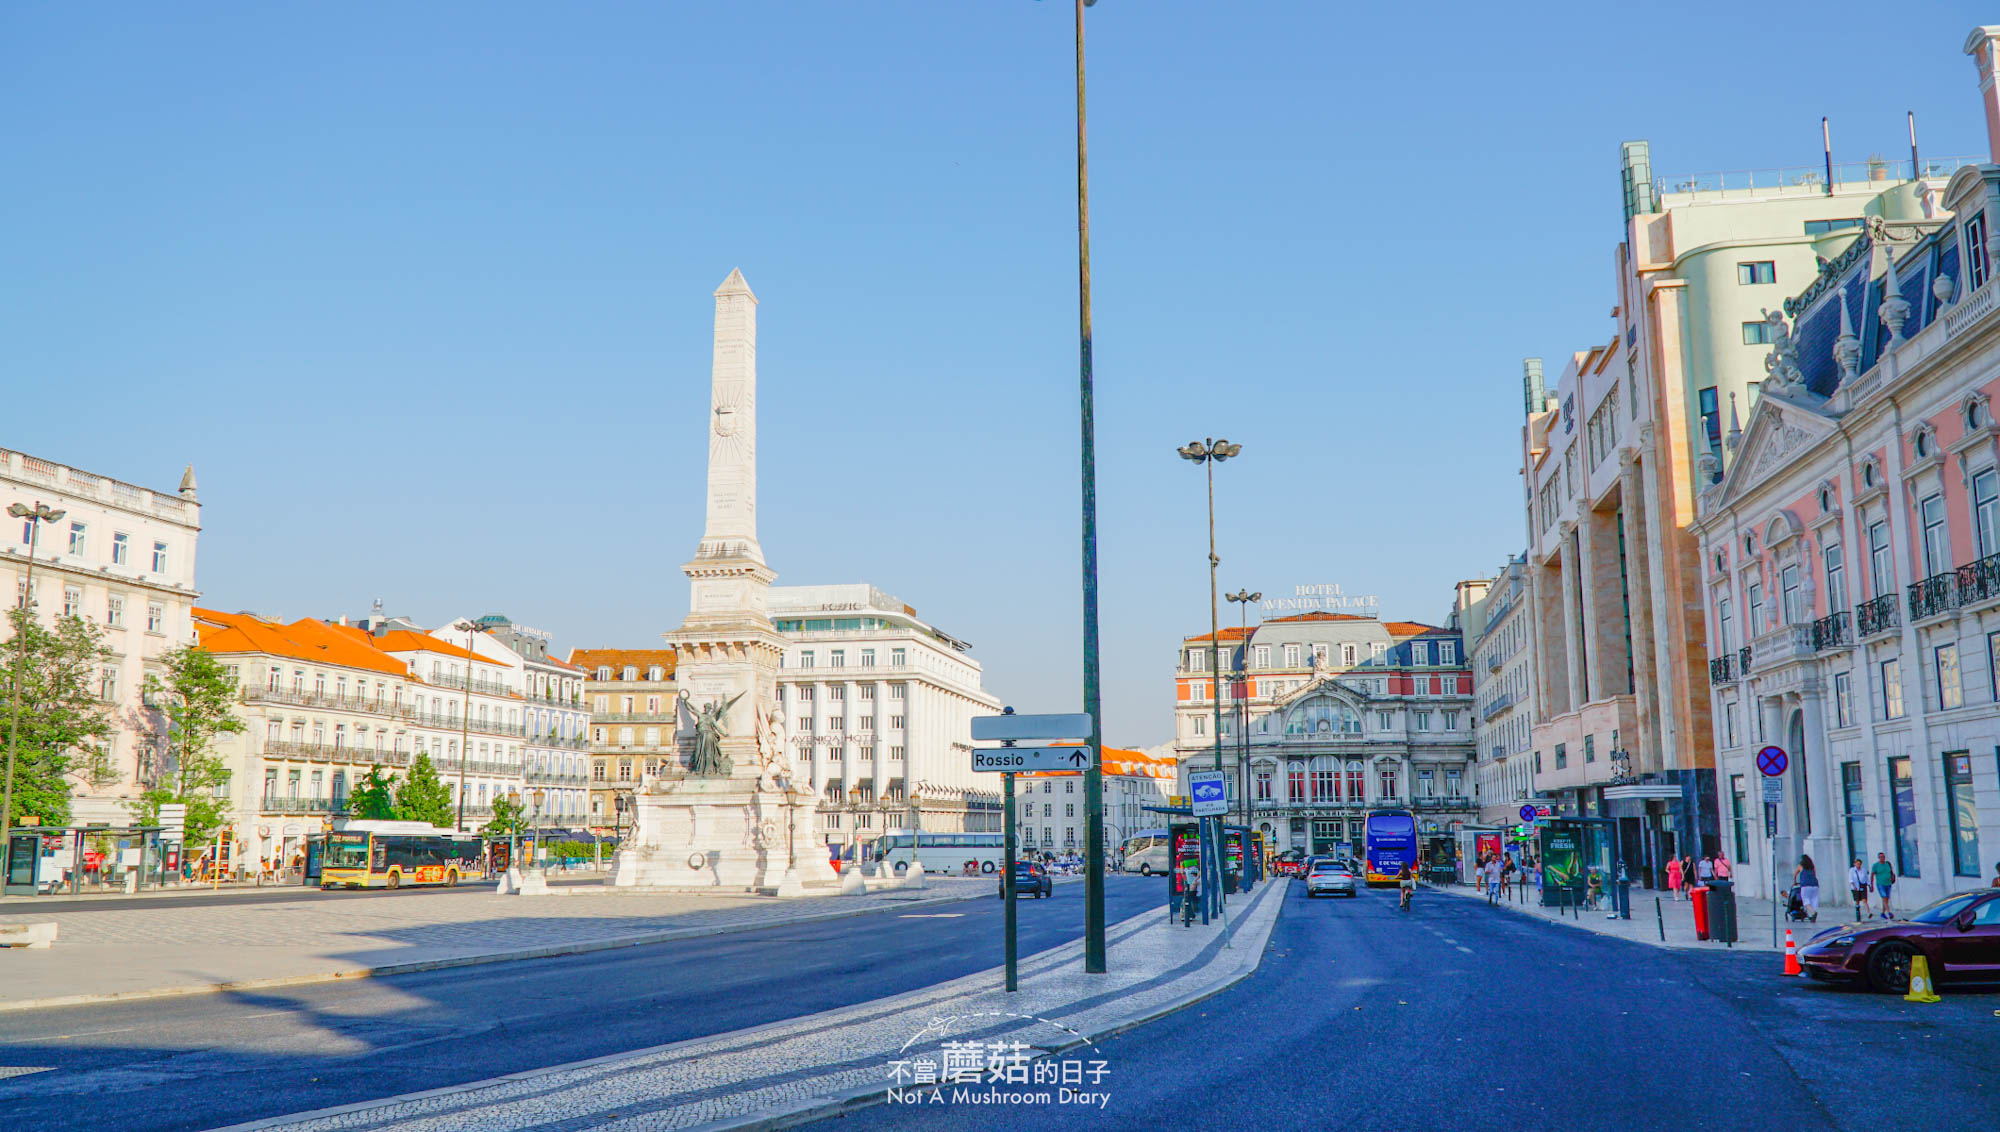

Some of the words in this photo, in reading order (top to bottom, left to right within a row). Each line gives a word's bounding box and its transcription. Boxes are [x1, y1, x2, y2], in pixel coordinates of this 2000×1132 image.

[1295, 583, 1344, 596] HOTEL
[1262, 598, 1321, 610] AVENIDA
[1325, 595, 1378, 608] PALACE
[844, 733, 882, 742] HOTEL
[975, 753, 1024, 766] Rossio
[1192, 773, 1222, 781] ATENÇÃO
